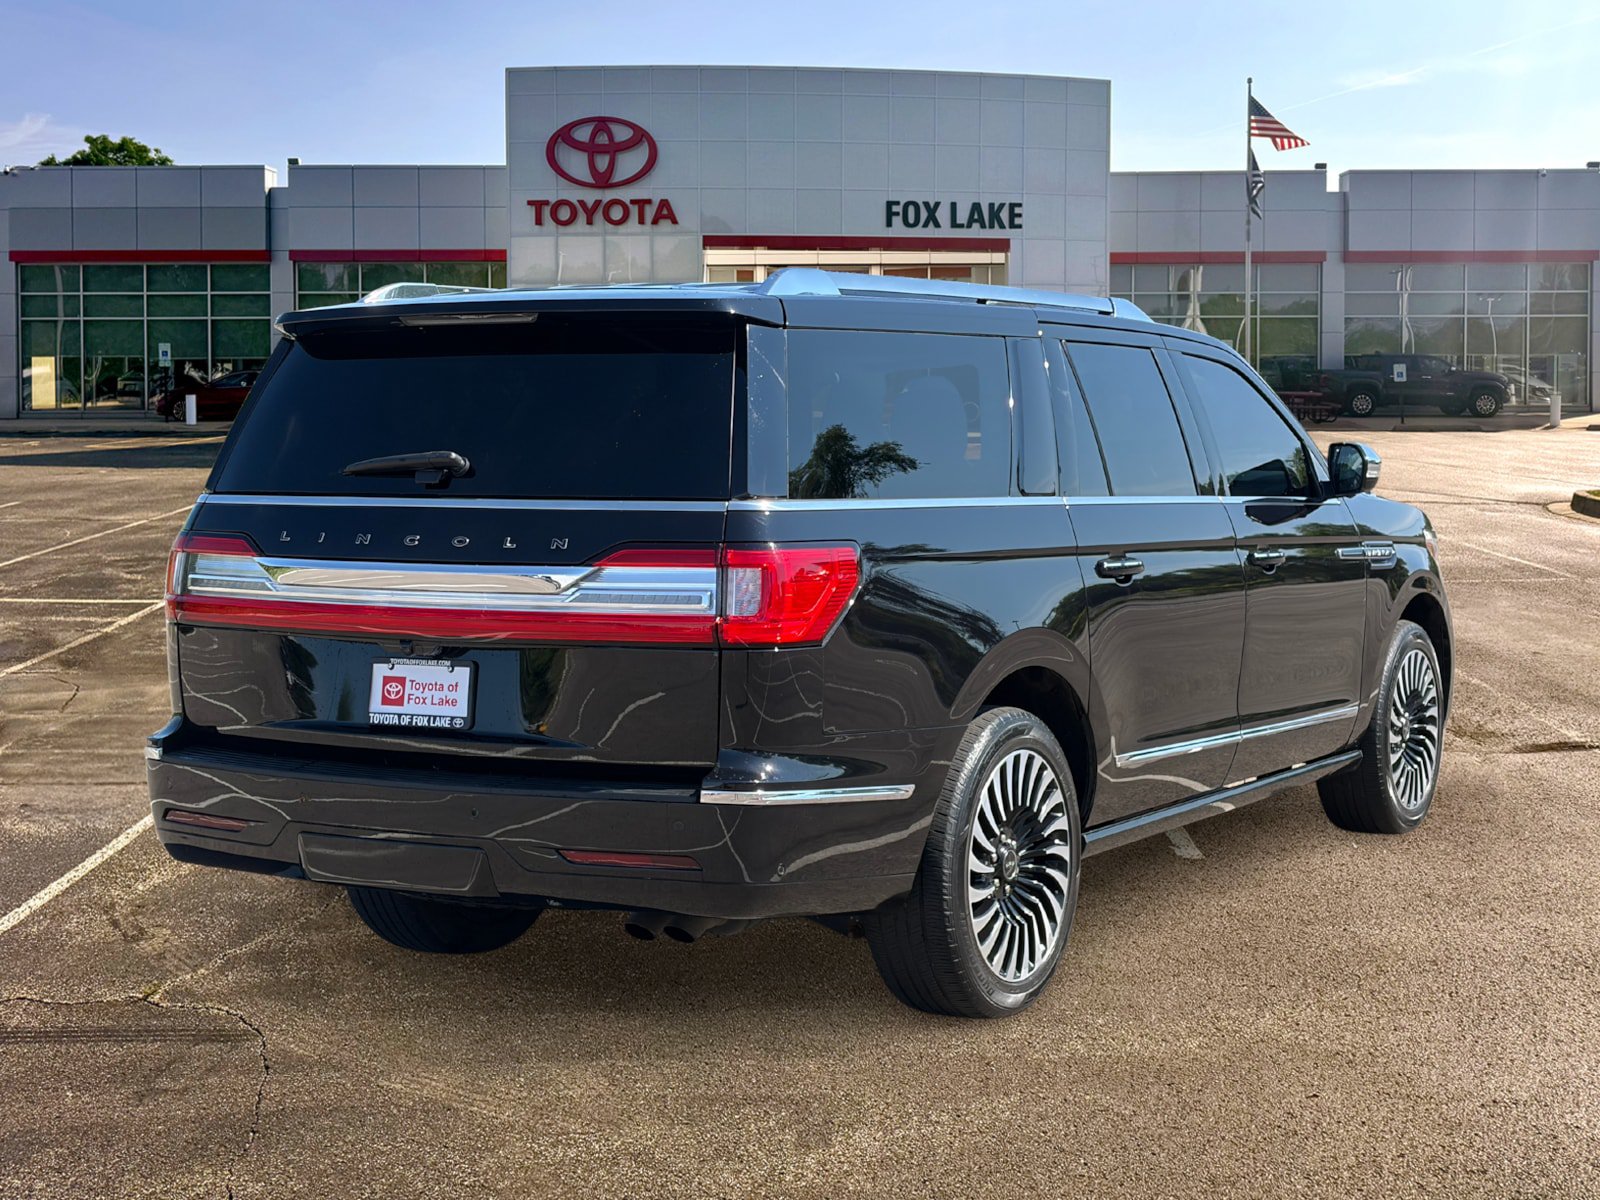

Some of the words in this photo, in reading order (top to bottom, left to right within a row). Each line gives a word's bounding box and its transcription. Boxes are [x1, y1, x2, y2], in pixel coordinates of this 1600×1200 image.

[526, 198, 679, 226] TOYOTA
[885, 200, 942, 229] FOX
[950, 201, 1023, 230] LAKE
[279, 530, 570, 551] LINCOLN
[409, 679, 445, 694] Toyota
[447, 681, 459, 693] of
[407, 694, 427, 706] Fox
[430, 695, 458, 707] Lake
[369, 713, 399, 725] TOYOTA
[400, 714, 412, 726] OF
[412, 715, 429, 727] FOX
[430, 717, 451, 728] LAKE
